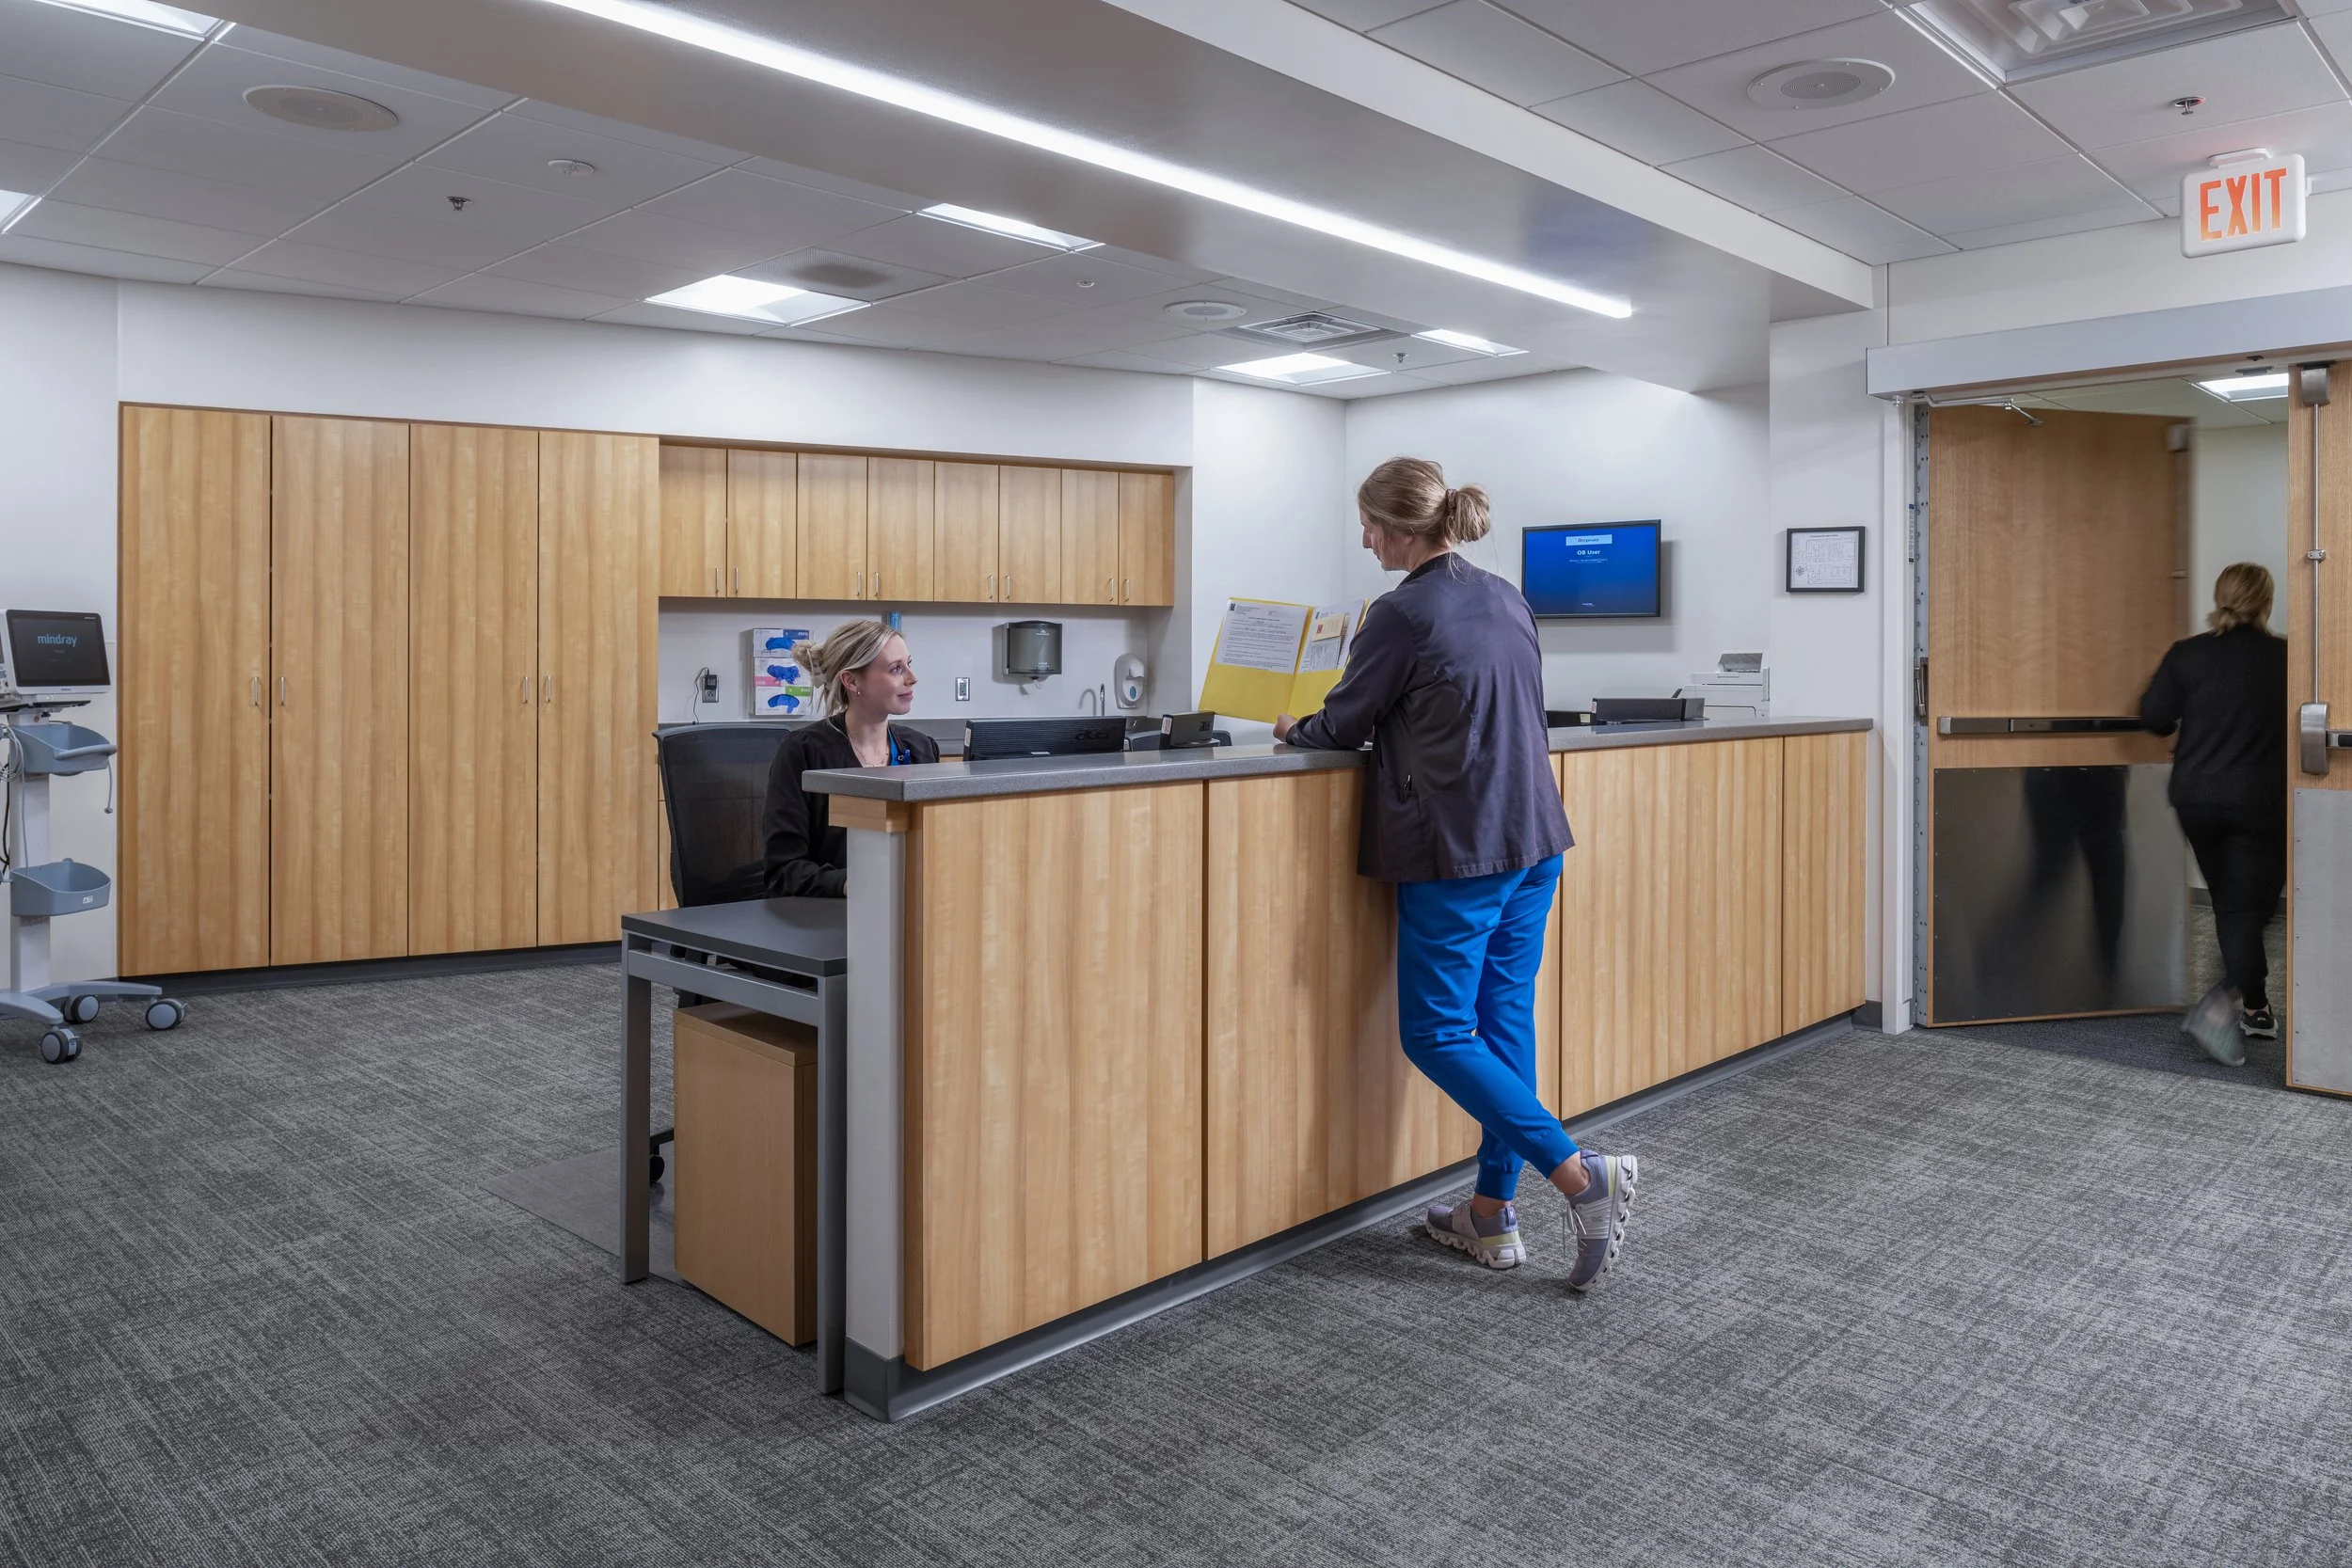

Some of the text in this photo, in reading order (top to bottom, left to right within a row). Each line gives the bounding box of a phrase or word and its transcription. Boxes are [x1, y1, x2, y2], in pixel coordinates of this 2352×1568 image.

[2199, 167, 2287, 242] EXIT
[37, 633, 77, 647] mindray
[1074, 727, 1114, 740] acer
